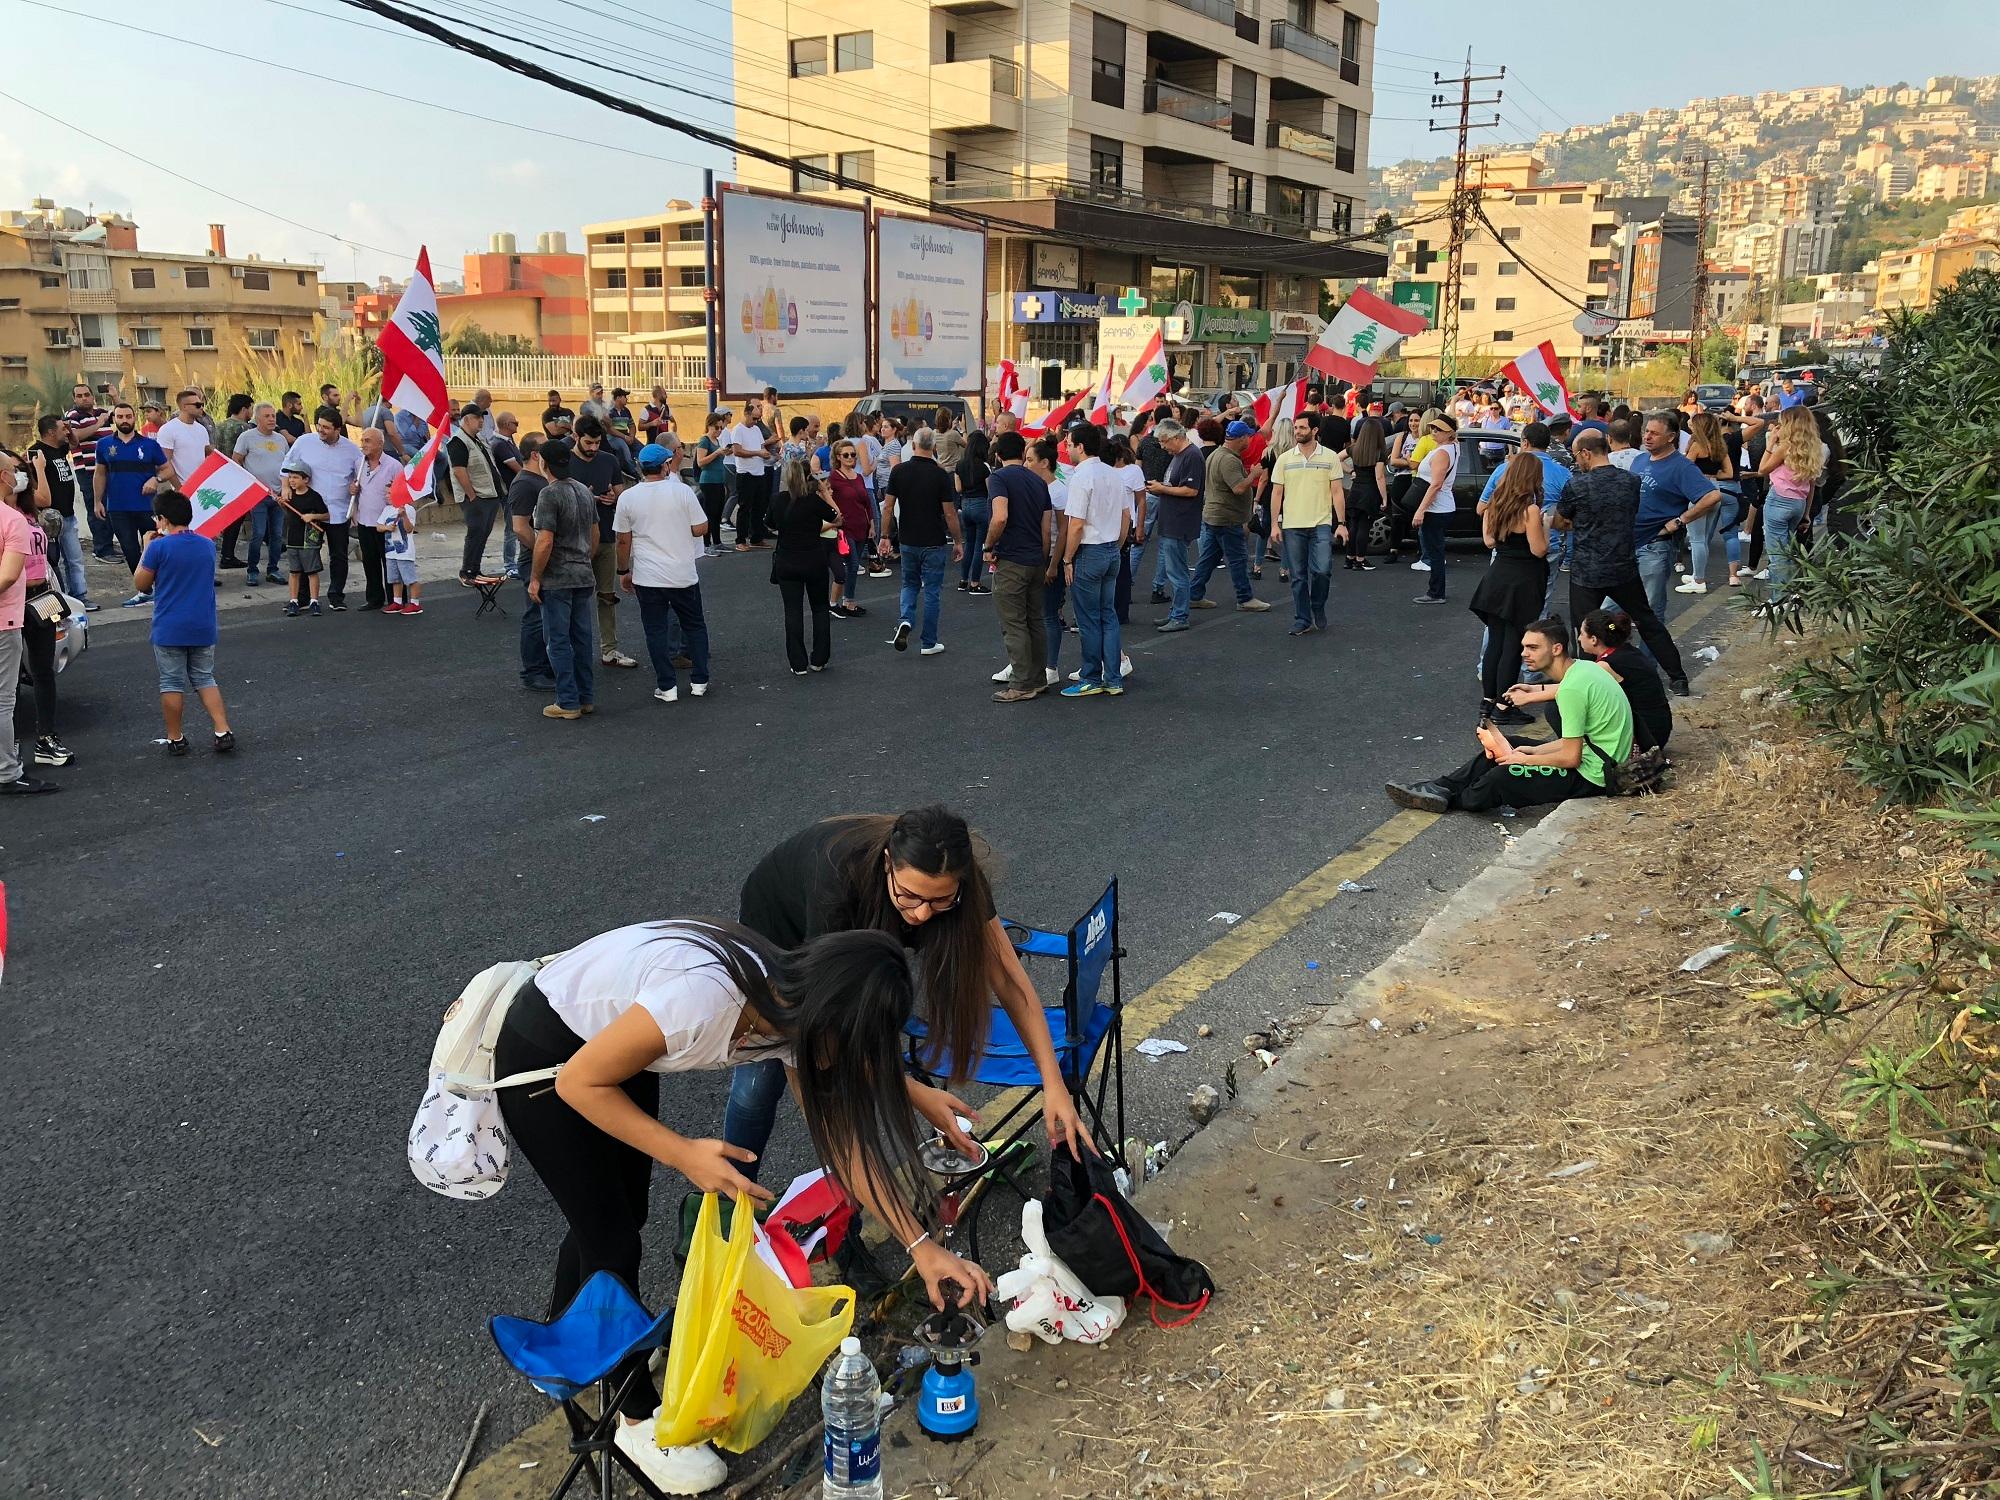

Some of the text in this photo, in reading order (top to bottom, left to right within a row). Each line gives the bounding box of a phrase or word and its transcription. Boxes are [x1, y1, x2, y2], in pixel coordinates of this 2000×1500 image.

[766, 213, 824, 244] NEW Johnson's
[919, 233, 953, 261] Johnson's
[427, 1181, 447, 1191] PUMA
[464, 1190, 484, 1199] PUMA
